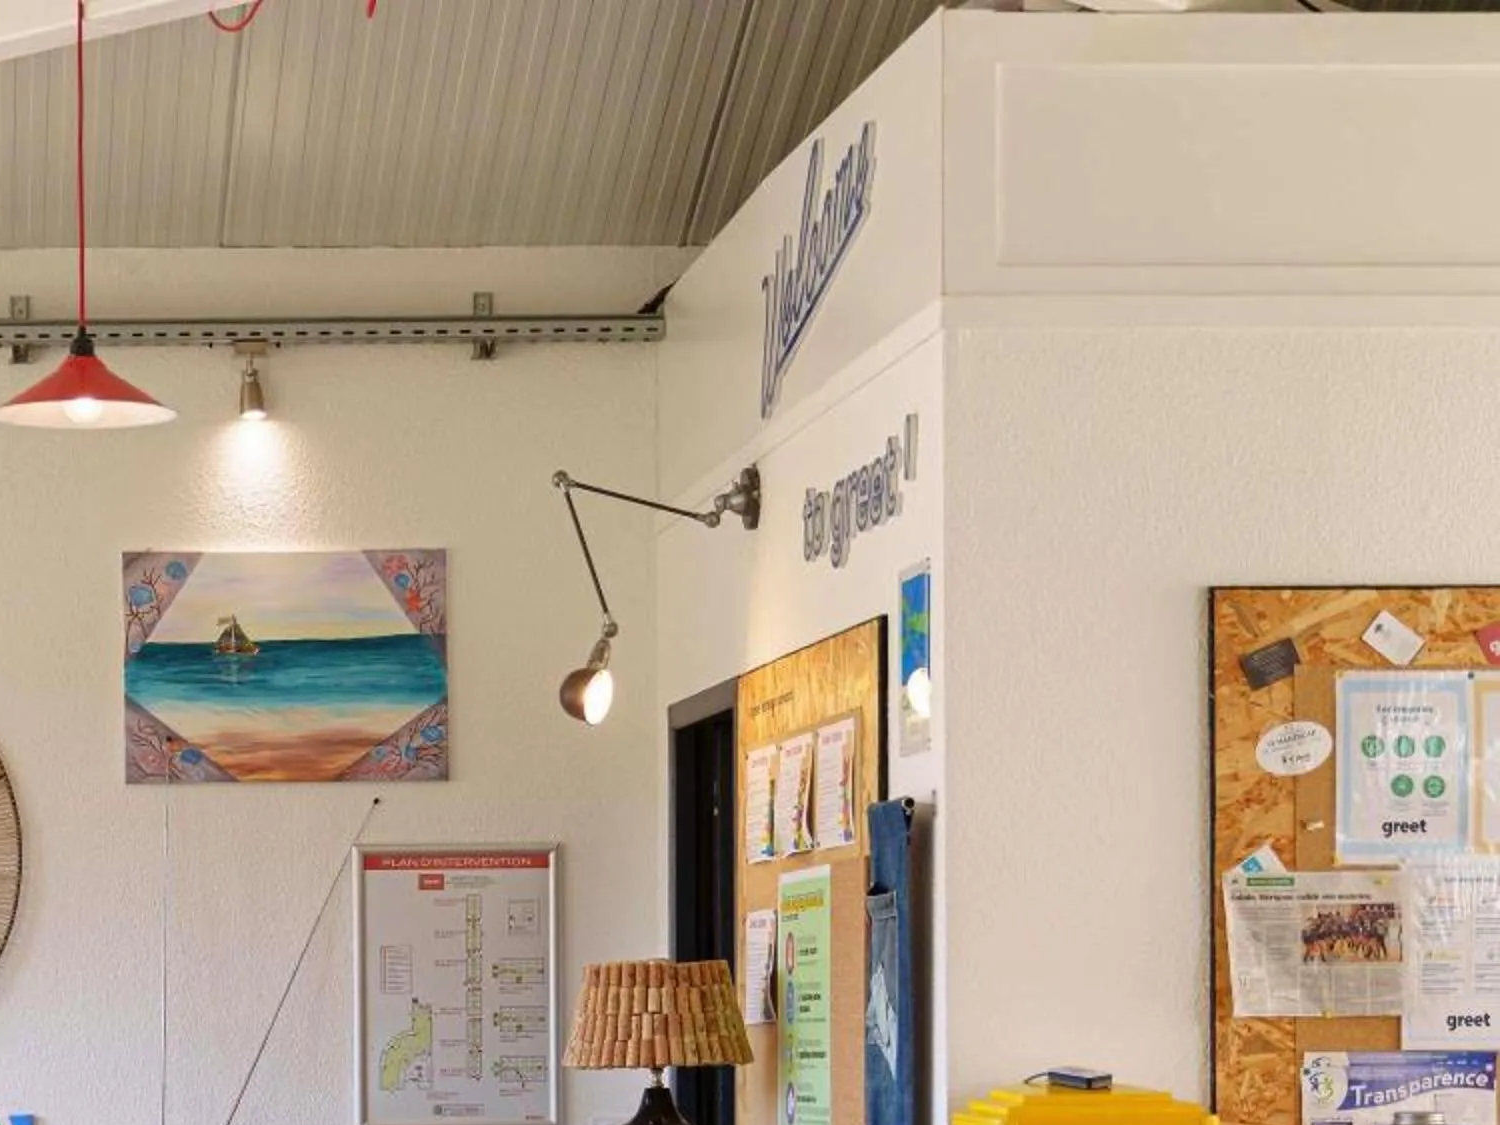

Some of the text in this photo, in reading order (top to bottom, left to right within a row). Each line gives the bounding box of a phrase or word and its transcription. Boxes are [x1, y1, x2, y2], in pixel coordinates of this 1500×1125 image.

[803, 488, 827, 561] to
[831, 435, 901, 568] greet
[1381, 818, 1428, 838] greet
[382, 857, 420, 868] PLAN
[1446, 1012, 1491, 1032] greet
[1350, 1069, 1489, 1107] Transparence
